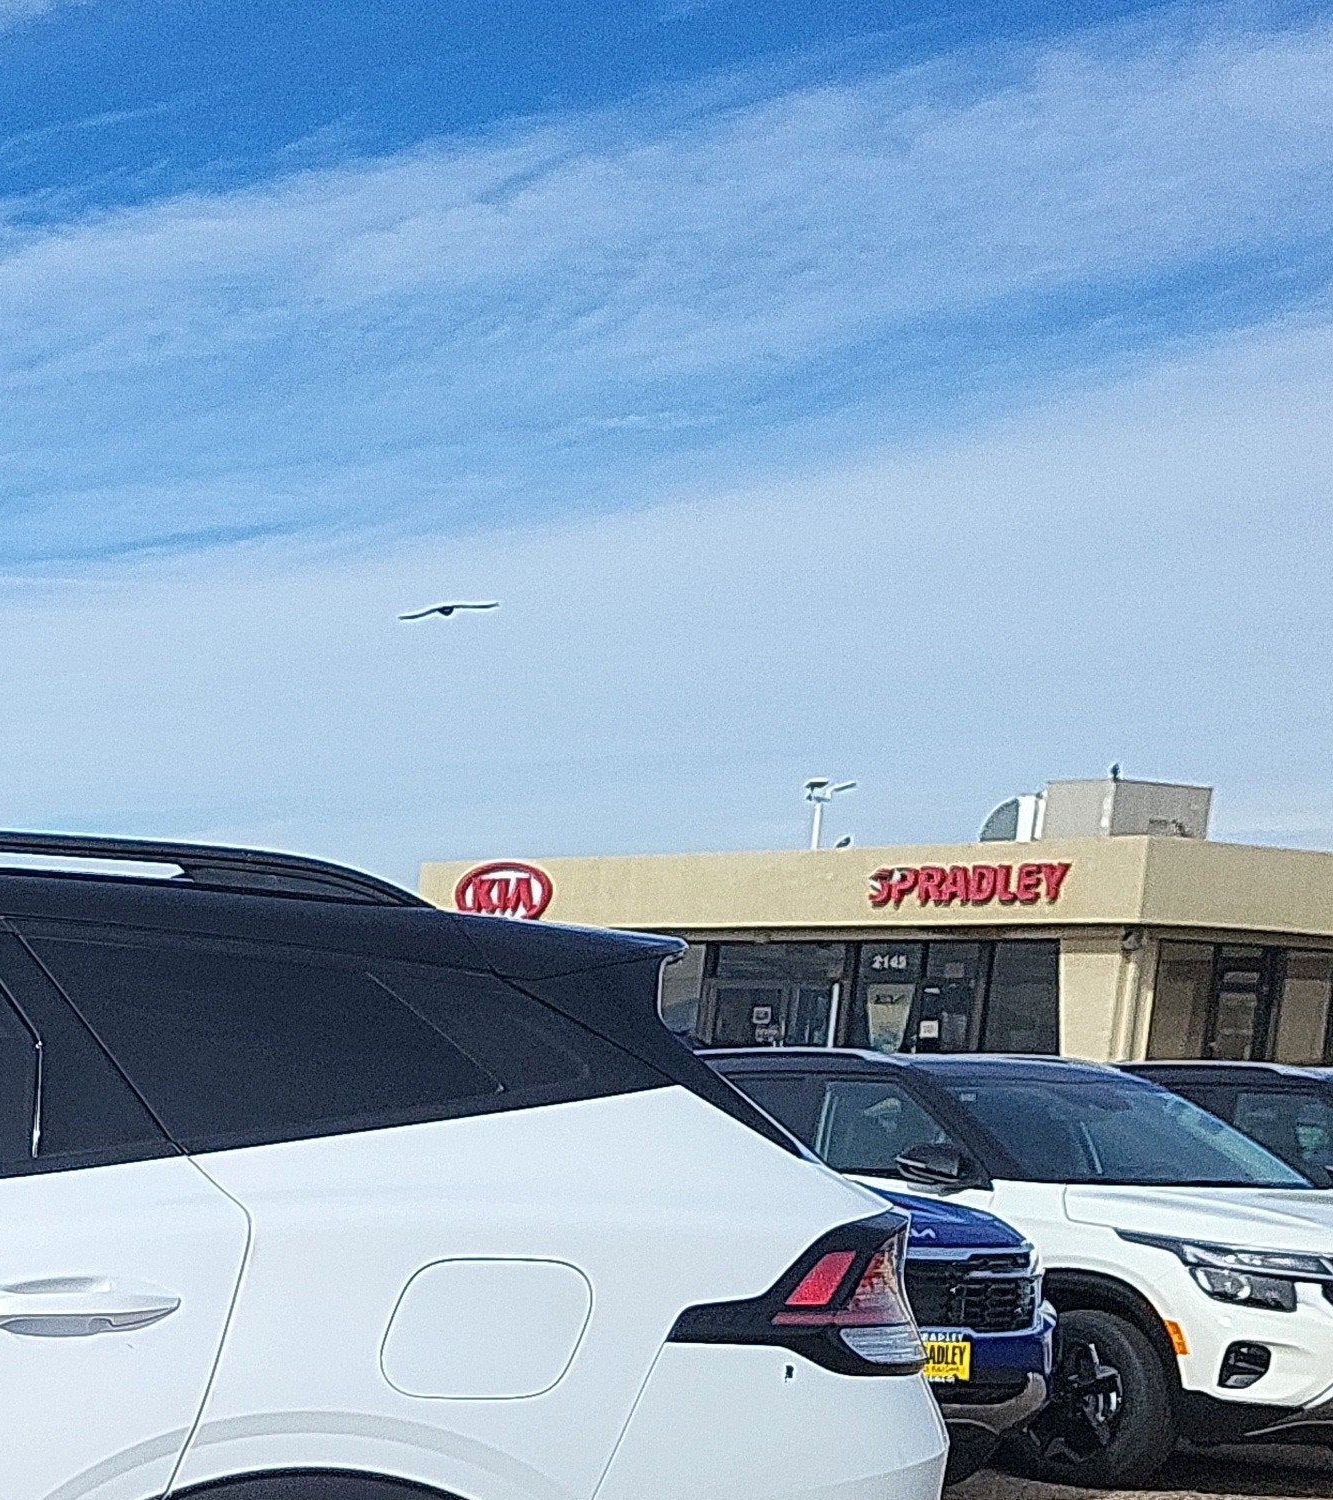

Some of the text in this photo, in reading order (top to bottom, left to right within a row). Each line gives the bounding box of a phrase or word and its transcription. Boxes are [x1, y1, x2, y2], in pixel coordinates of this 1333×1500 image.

[472, 877, 538, 915] KIA
[869, 862, 1072, 909] SPRADLEY
[926, 1344, 967, 1366] ADLEY
